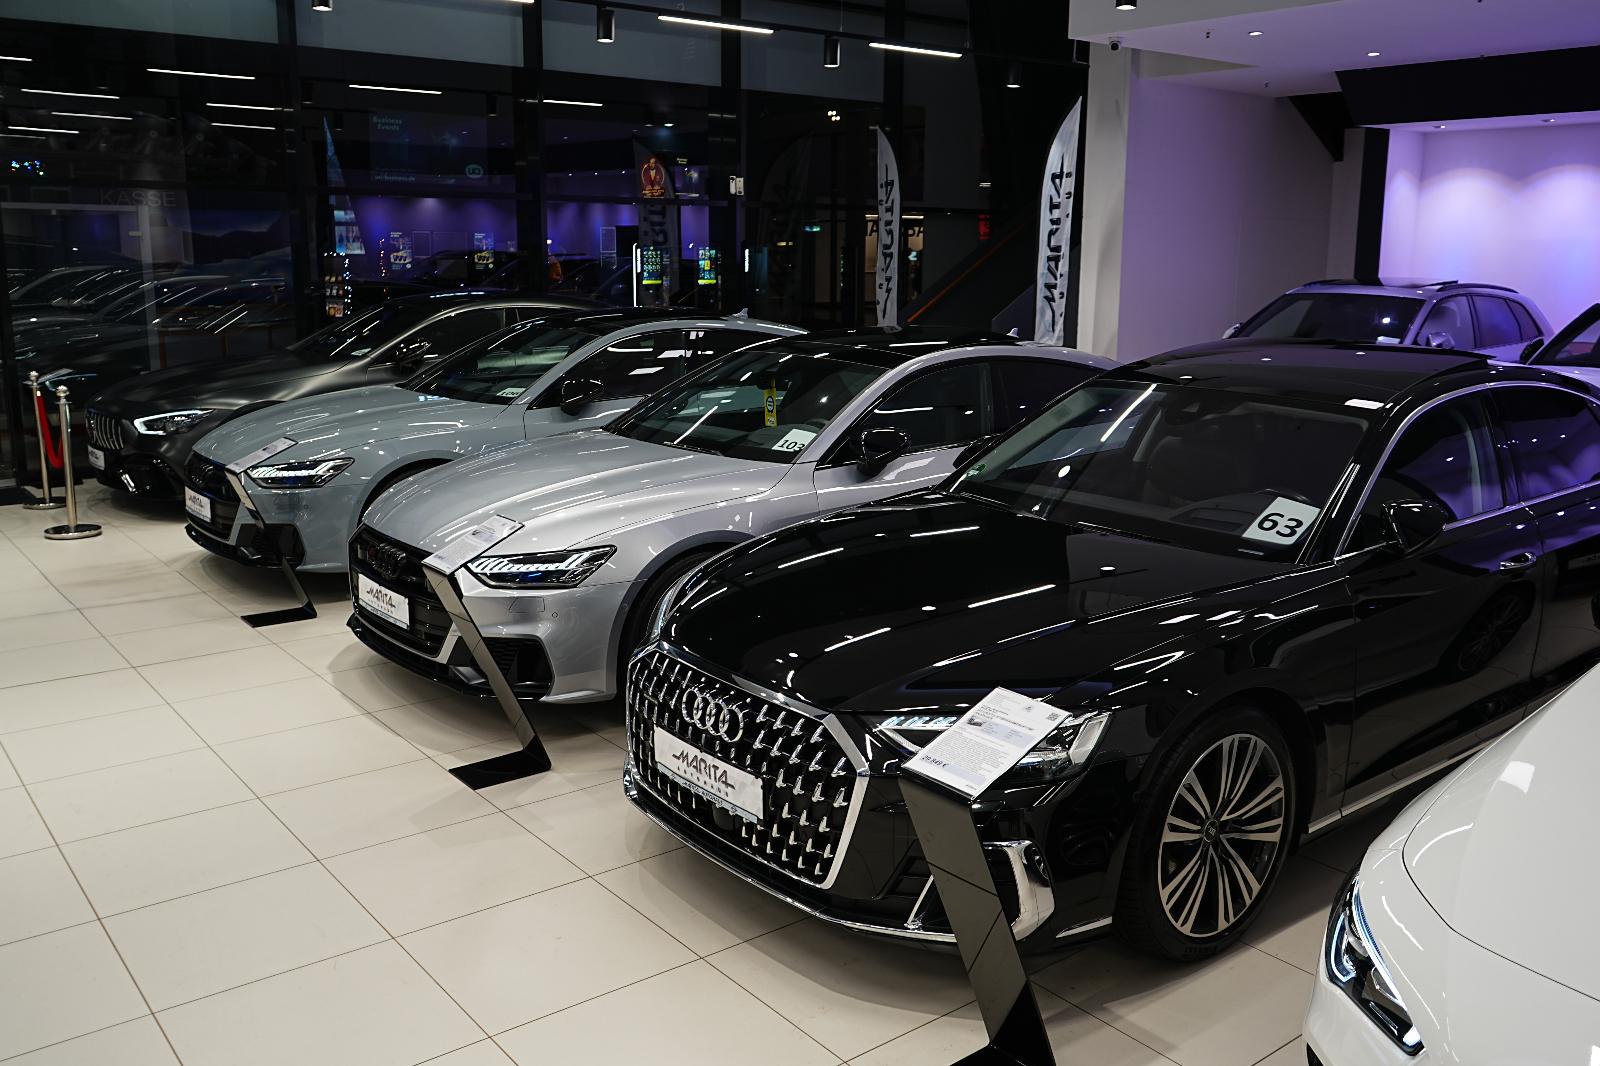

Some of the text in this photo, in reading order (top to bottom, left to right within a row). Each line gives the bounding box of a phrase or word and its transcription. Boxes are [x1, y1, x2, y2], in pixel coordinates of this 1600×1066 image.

[101, 190, 177, 207] KASSE
[1043, 153, 1065, 333] MARITA
[1257, 512, 1304, 538] 63
[671, 749, 736, 790] MARITA
